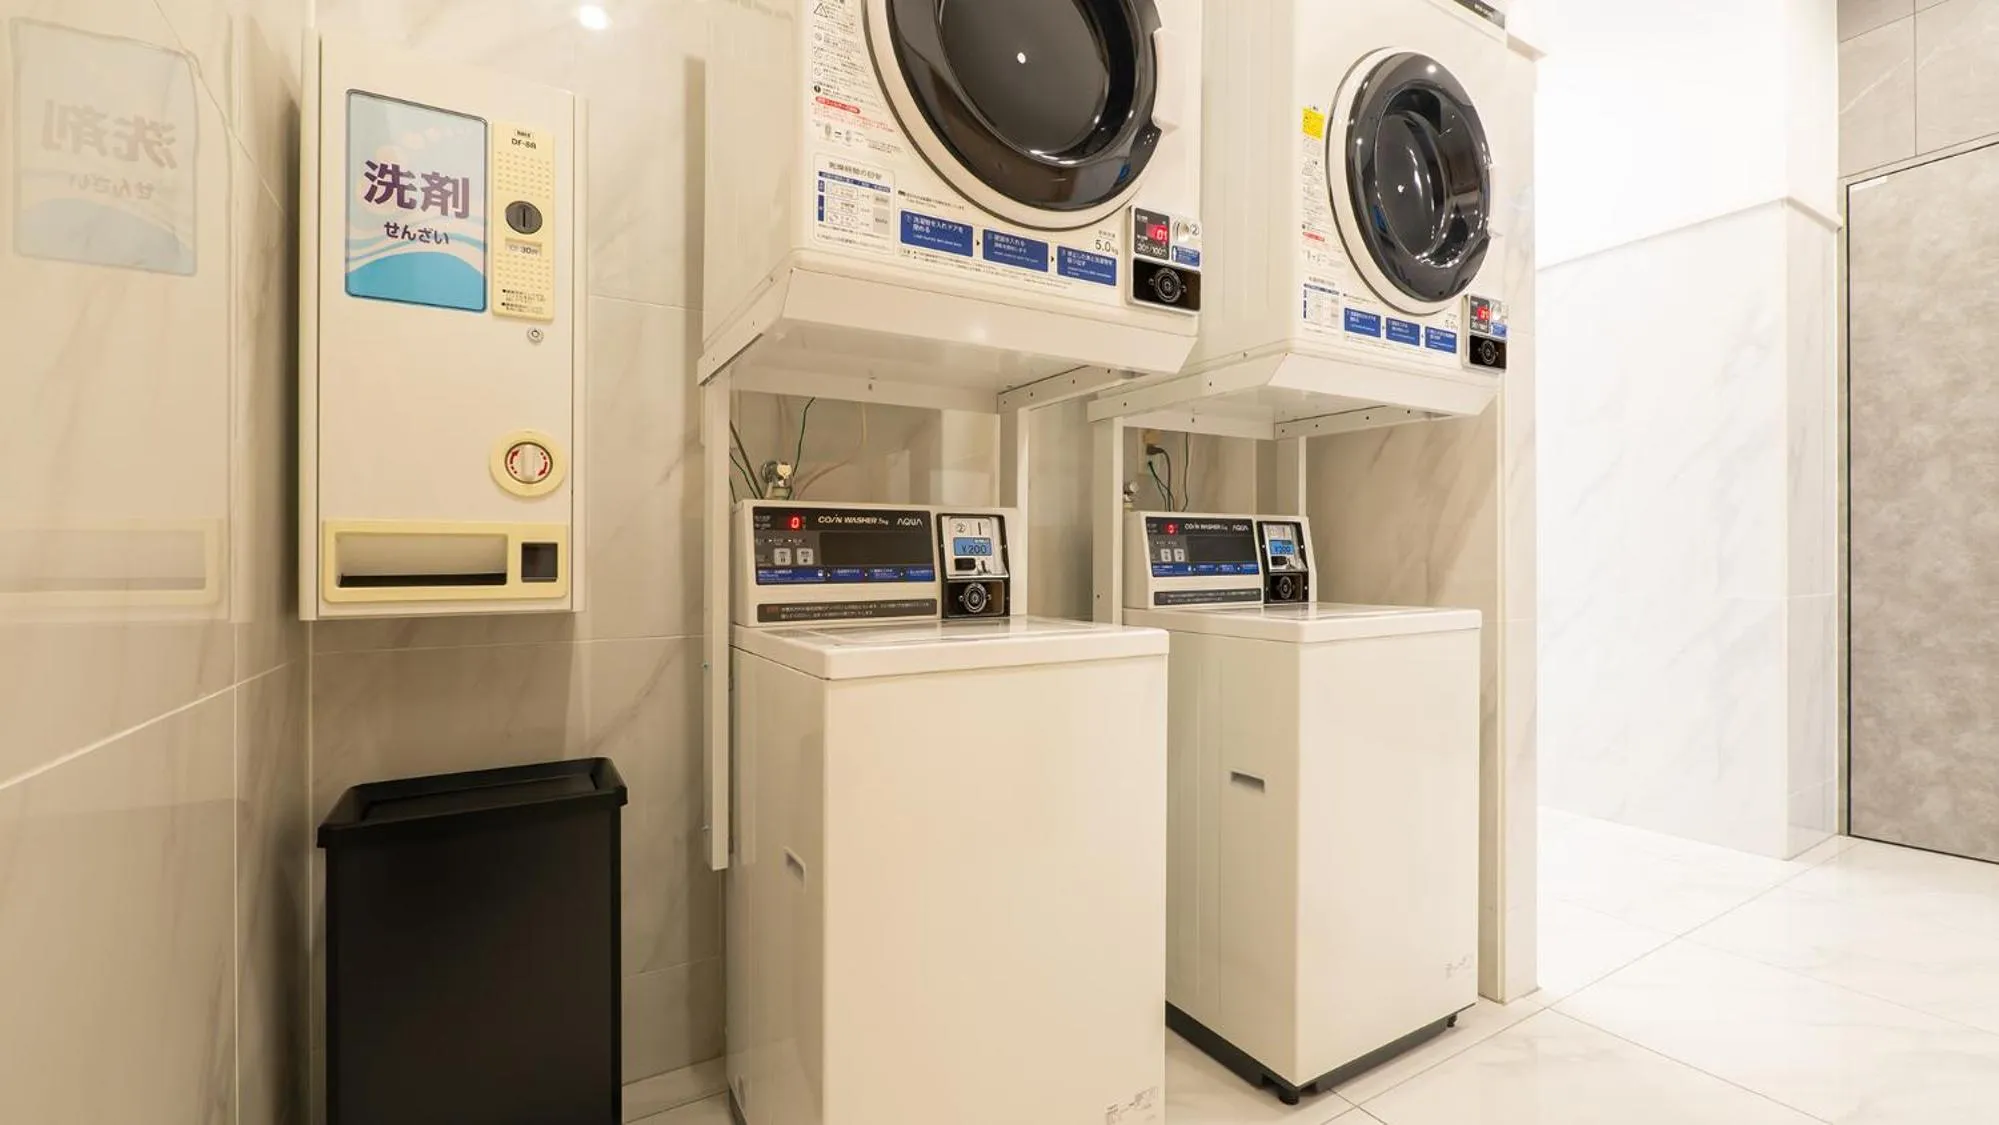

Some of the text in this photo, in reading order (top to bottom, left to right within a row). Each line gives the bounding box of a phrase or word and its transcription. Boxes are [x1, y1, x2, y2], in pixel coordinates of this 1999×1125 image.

[364, 159, 470, 219] 洗剤
[384, 221, 449, 245] せんざい
[844, 516, 877, 525] WASHER
[896, 517, 923, 528] AQUA
